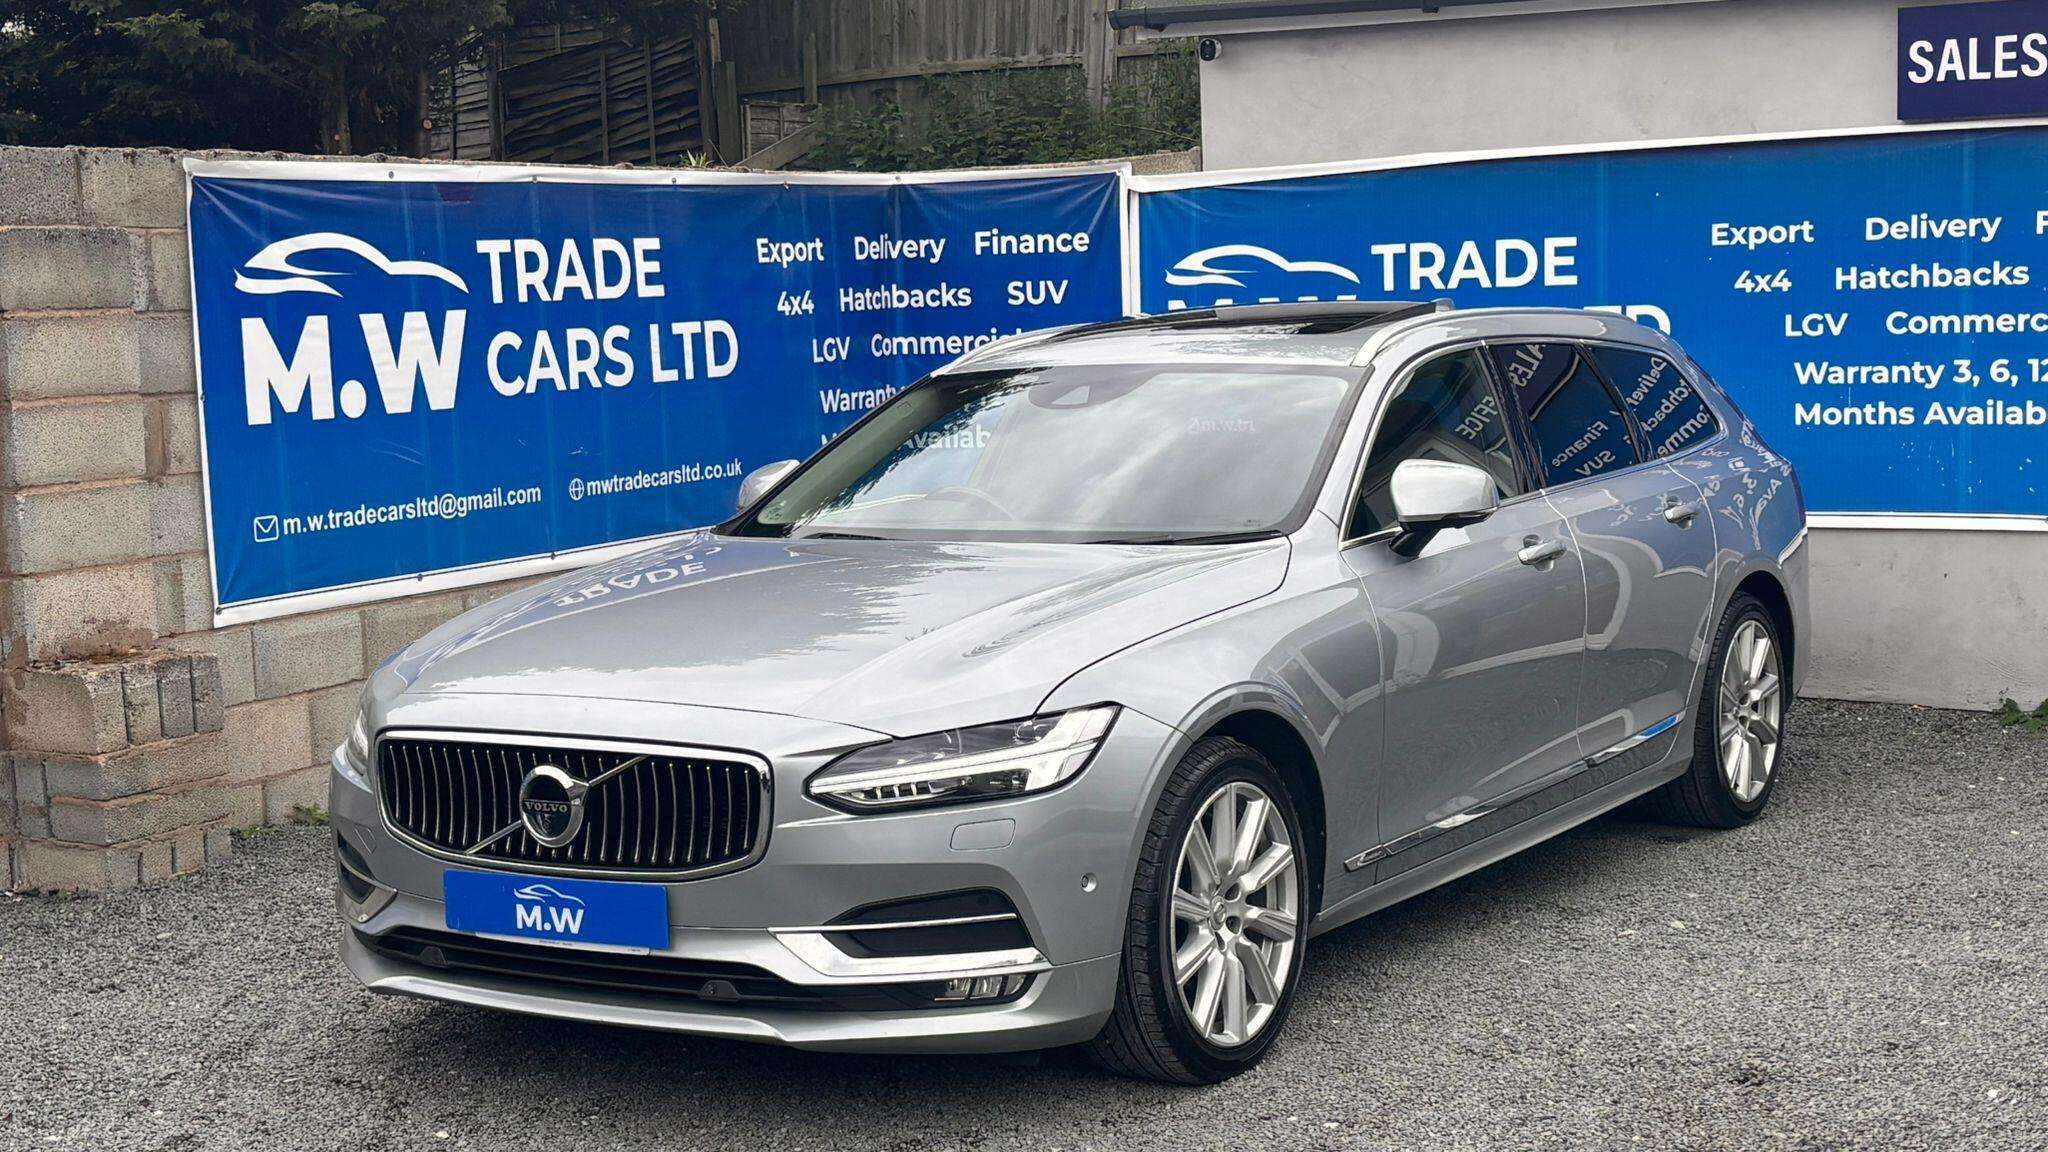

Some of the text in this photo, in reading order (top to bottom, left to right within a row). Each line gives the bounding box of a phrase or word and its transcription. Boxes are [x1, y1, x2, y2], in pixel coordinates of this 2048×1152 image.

[1907, 32, 2048, 84] SALES
[756, 229, 1090, 268] Export Delivery Finance
[1711, 218, 1815, 250] Export
[1865, 213, 2002, 243] Delivery
[476, 237, 665, 304] TRADE
[1371, 236, 1578, 292] TRADE
[1734, 261, 2029, 293] 4x4 Hatchbacks
[776, 279, 1069, 317] 4x4 Hatchbacks SUV
[1784, 312, 1848, 338] LGV
[486, 318, 740, 397] CARS LTD
[812, 327, 1022, 364] LGV Commerci
[240, 309, 467, 426] M.W
[1794, 359, 1945, 390] Warranty
[1952, 359, 1981, 387] 3,
[1989, 358, 2019, 387] 6,
[1794, 401, 1915, 426] Months
[586, 457, 742, 496] mwtradecarsltd.co.uk
[282, 486, 542, 535] m.w.tradecarsltd@gmail.com
[524, 801, 568, 813] VOLVO
[515, 903, 584, 935] M.W
